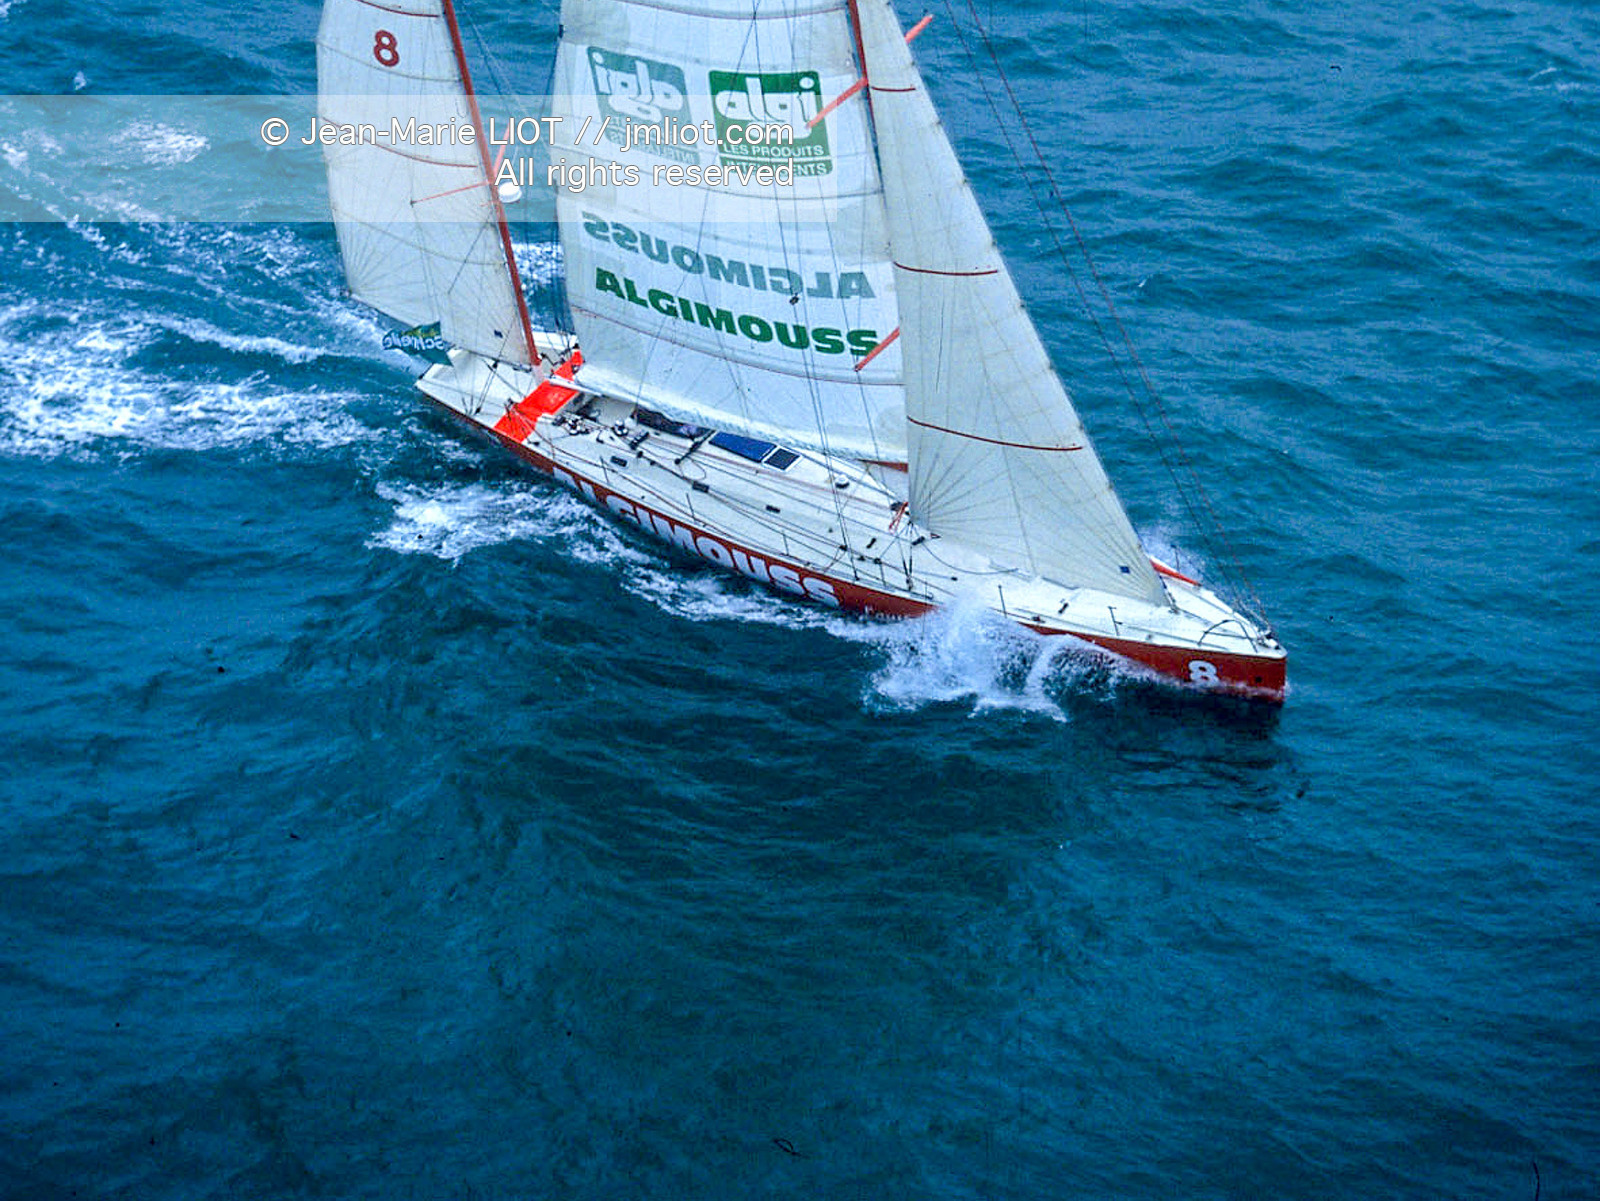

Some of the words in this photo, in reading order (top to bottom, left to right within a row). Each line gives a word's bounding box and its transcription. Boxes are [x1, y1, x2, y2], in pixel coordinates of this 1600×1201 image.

[373, 30, 399, 67] 8
[715, 77, 818, 139] algi
[723, 143, 749, 155] LES
[751, 145, 824, 157] PRODUITS
[596, 267, 878, 356] ALGIMOUSS
[1188, 660, 1219, 688] 8
